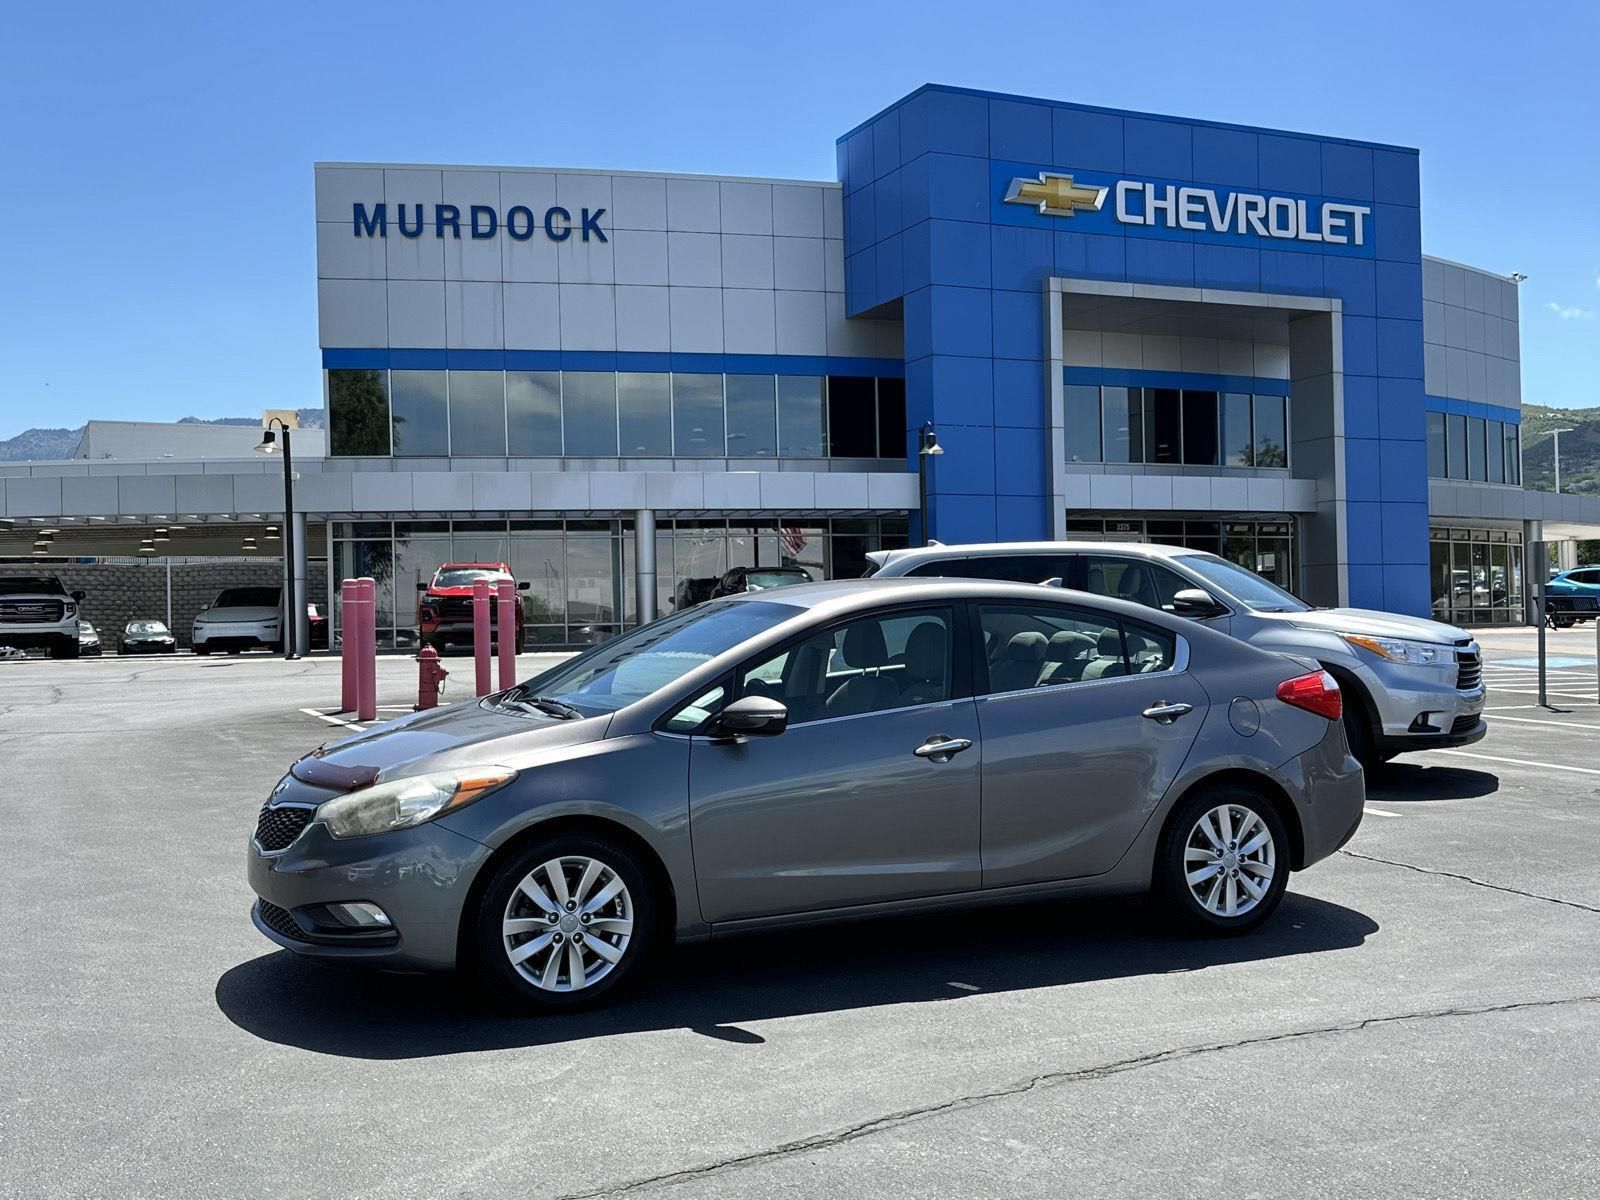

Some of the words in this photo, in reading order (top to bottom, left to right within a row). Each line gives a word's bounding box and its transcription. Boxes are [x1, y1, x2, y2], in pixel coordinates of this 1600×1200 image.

[353, 203, 608, 243] MURDOCK
[1115, 180, 1371, 245] CHEVROLET
[17, 605, 45, 613] GMC
